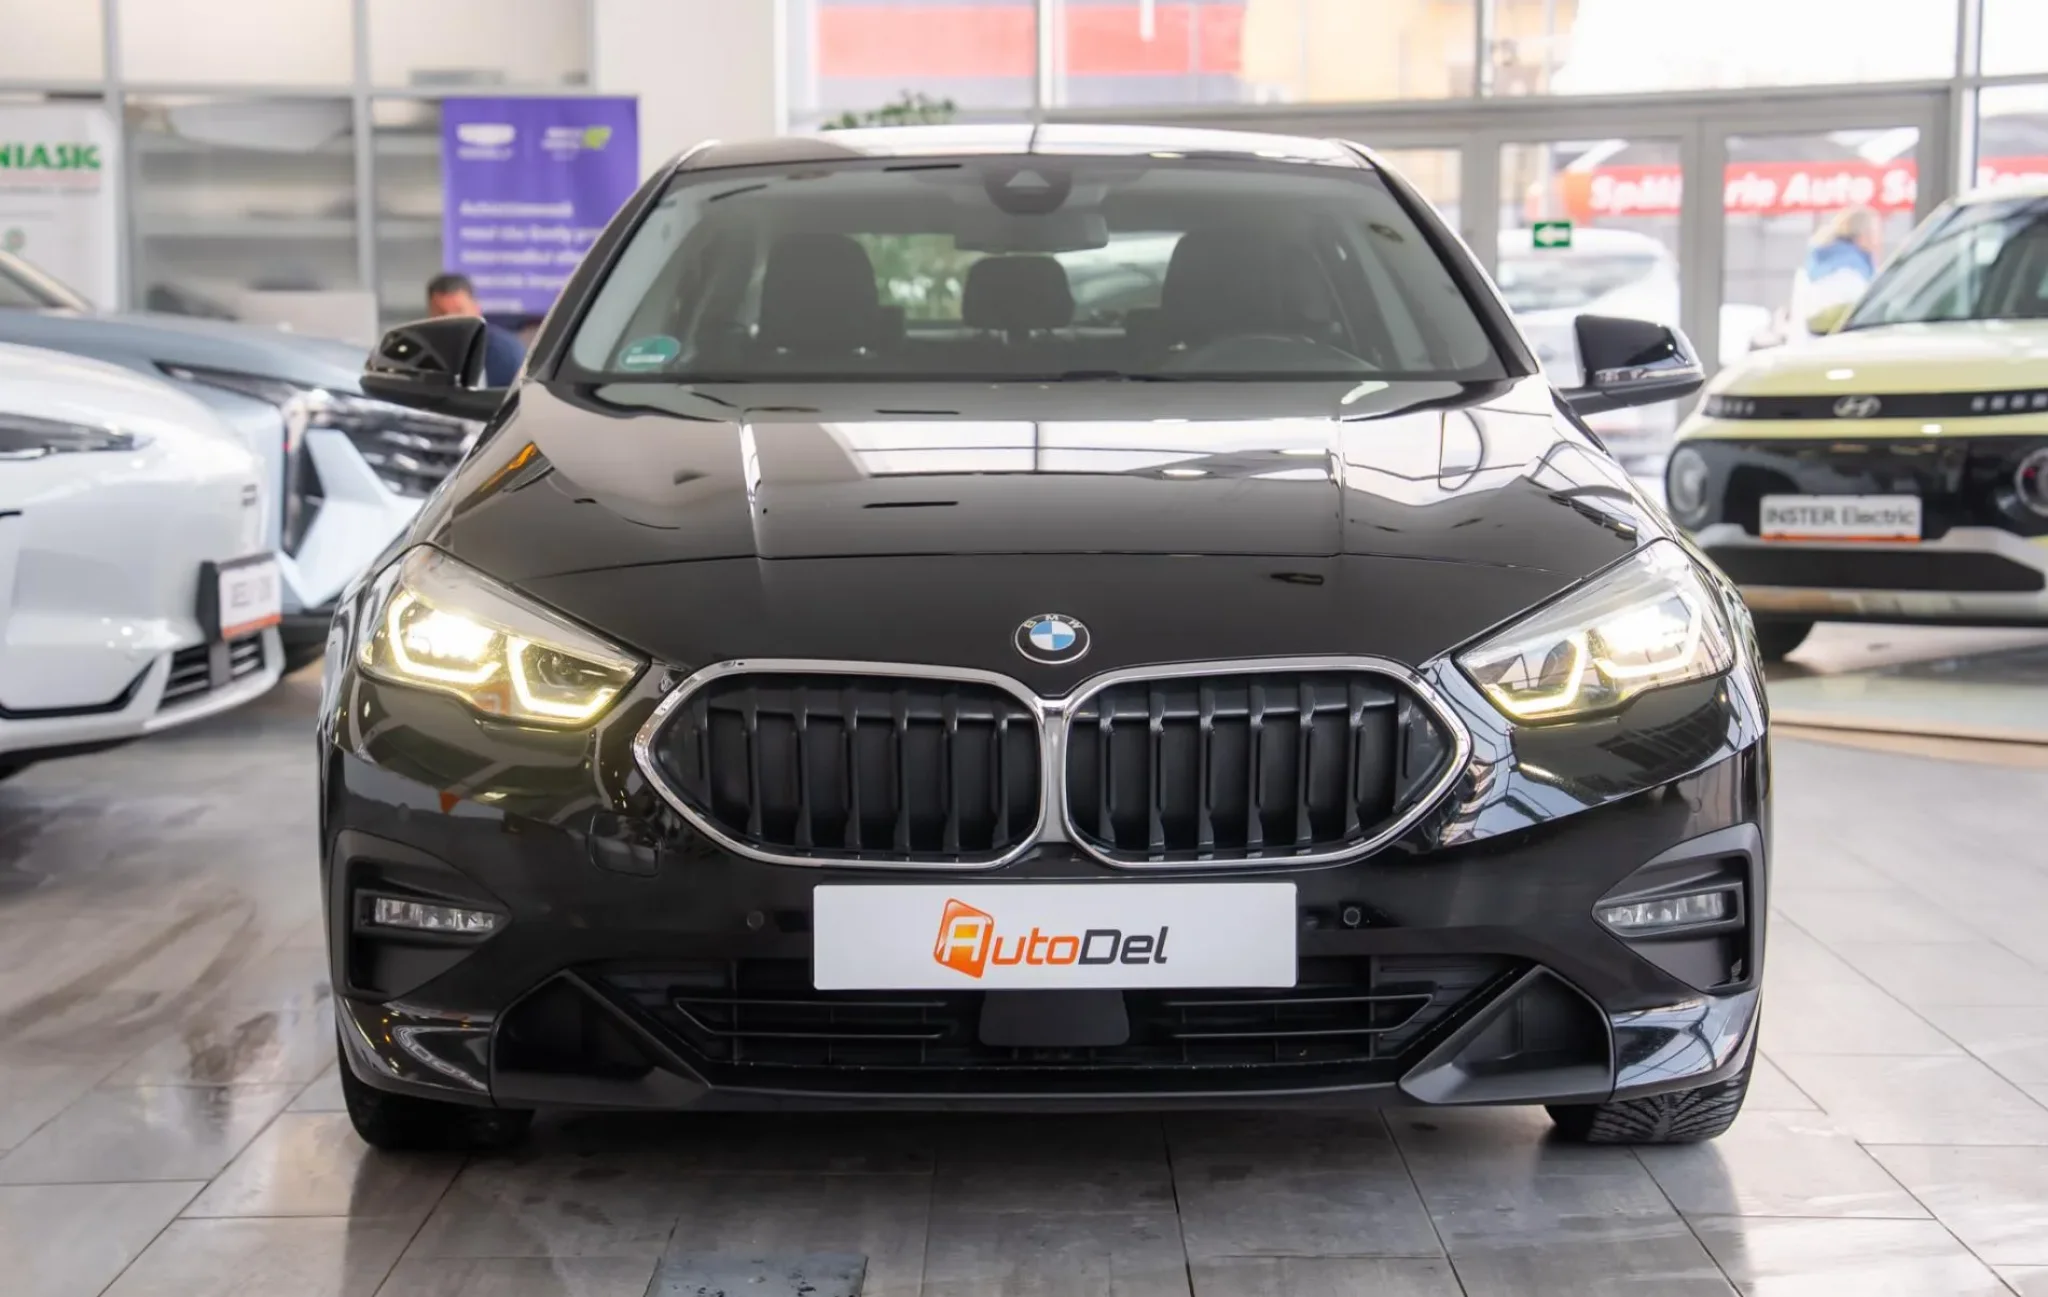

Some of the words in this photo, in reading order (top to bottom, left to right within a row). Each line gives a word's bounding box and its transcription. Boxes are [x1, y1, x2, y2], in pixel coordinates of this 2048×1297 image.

[1766, 505, 1837, 526] INSTER
[1841, 505, 1916, 526] Electric
[1023, 613, 1084, 629] BMW
[940, 914, 1169, 966] AutoDel
